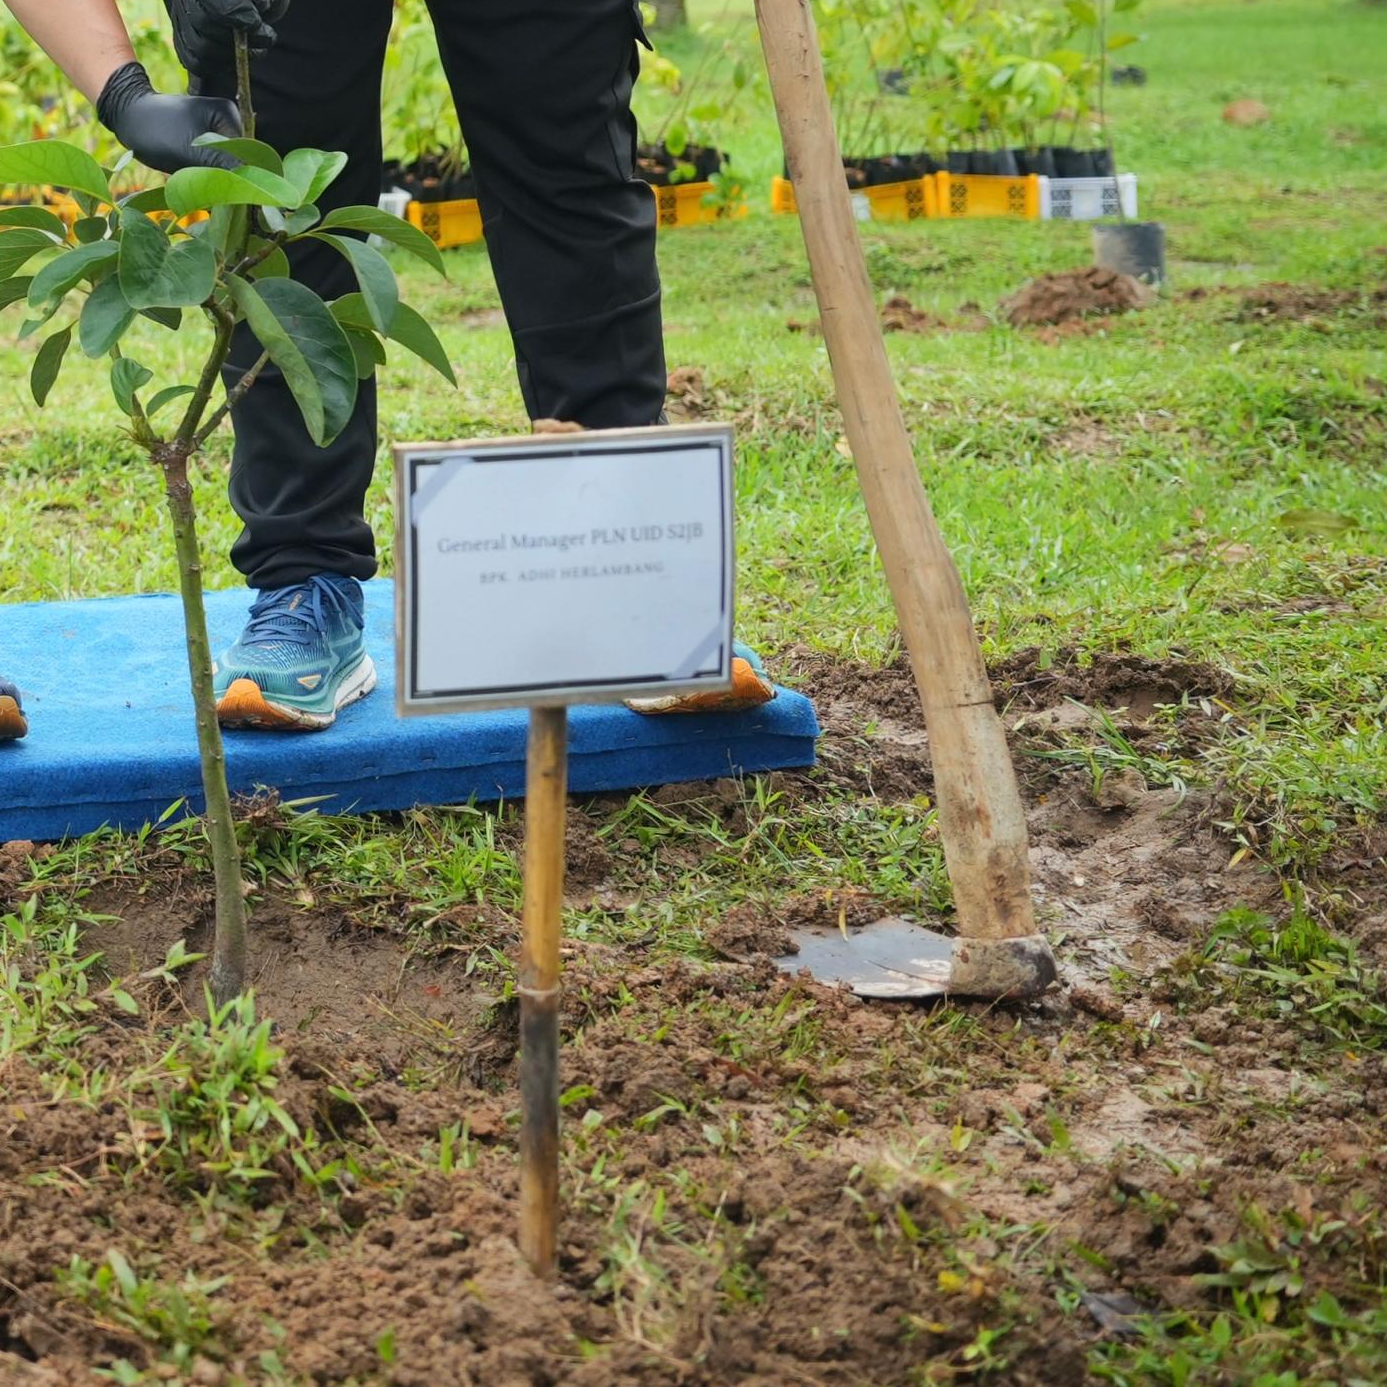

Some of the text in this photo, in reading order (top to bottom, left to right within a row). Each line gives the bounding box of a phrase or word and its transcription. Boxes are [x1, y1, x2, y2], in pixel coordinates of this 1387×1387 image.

[436, 533, 507, 554] General
[511, 529, 587, 552] Manager
[590, 526, 627, 545] PLN
[630, 523, 664, 542] UID
